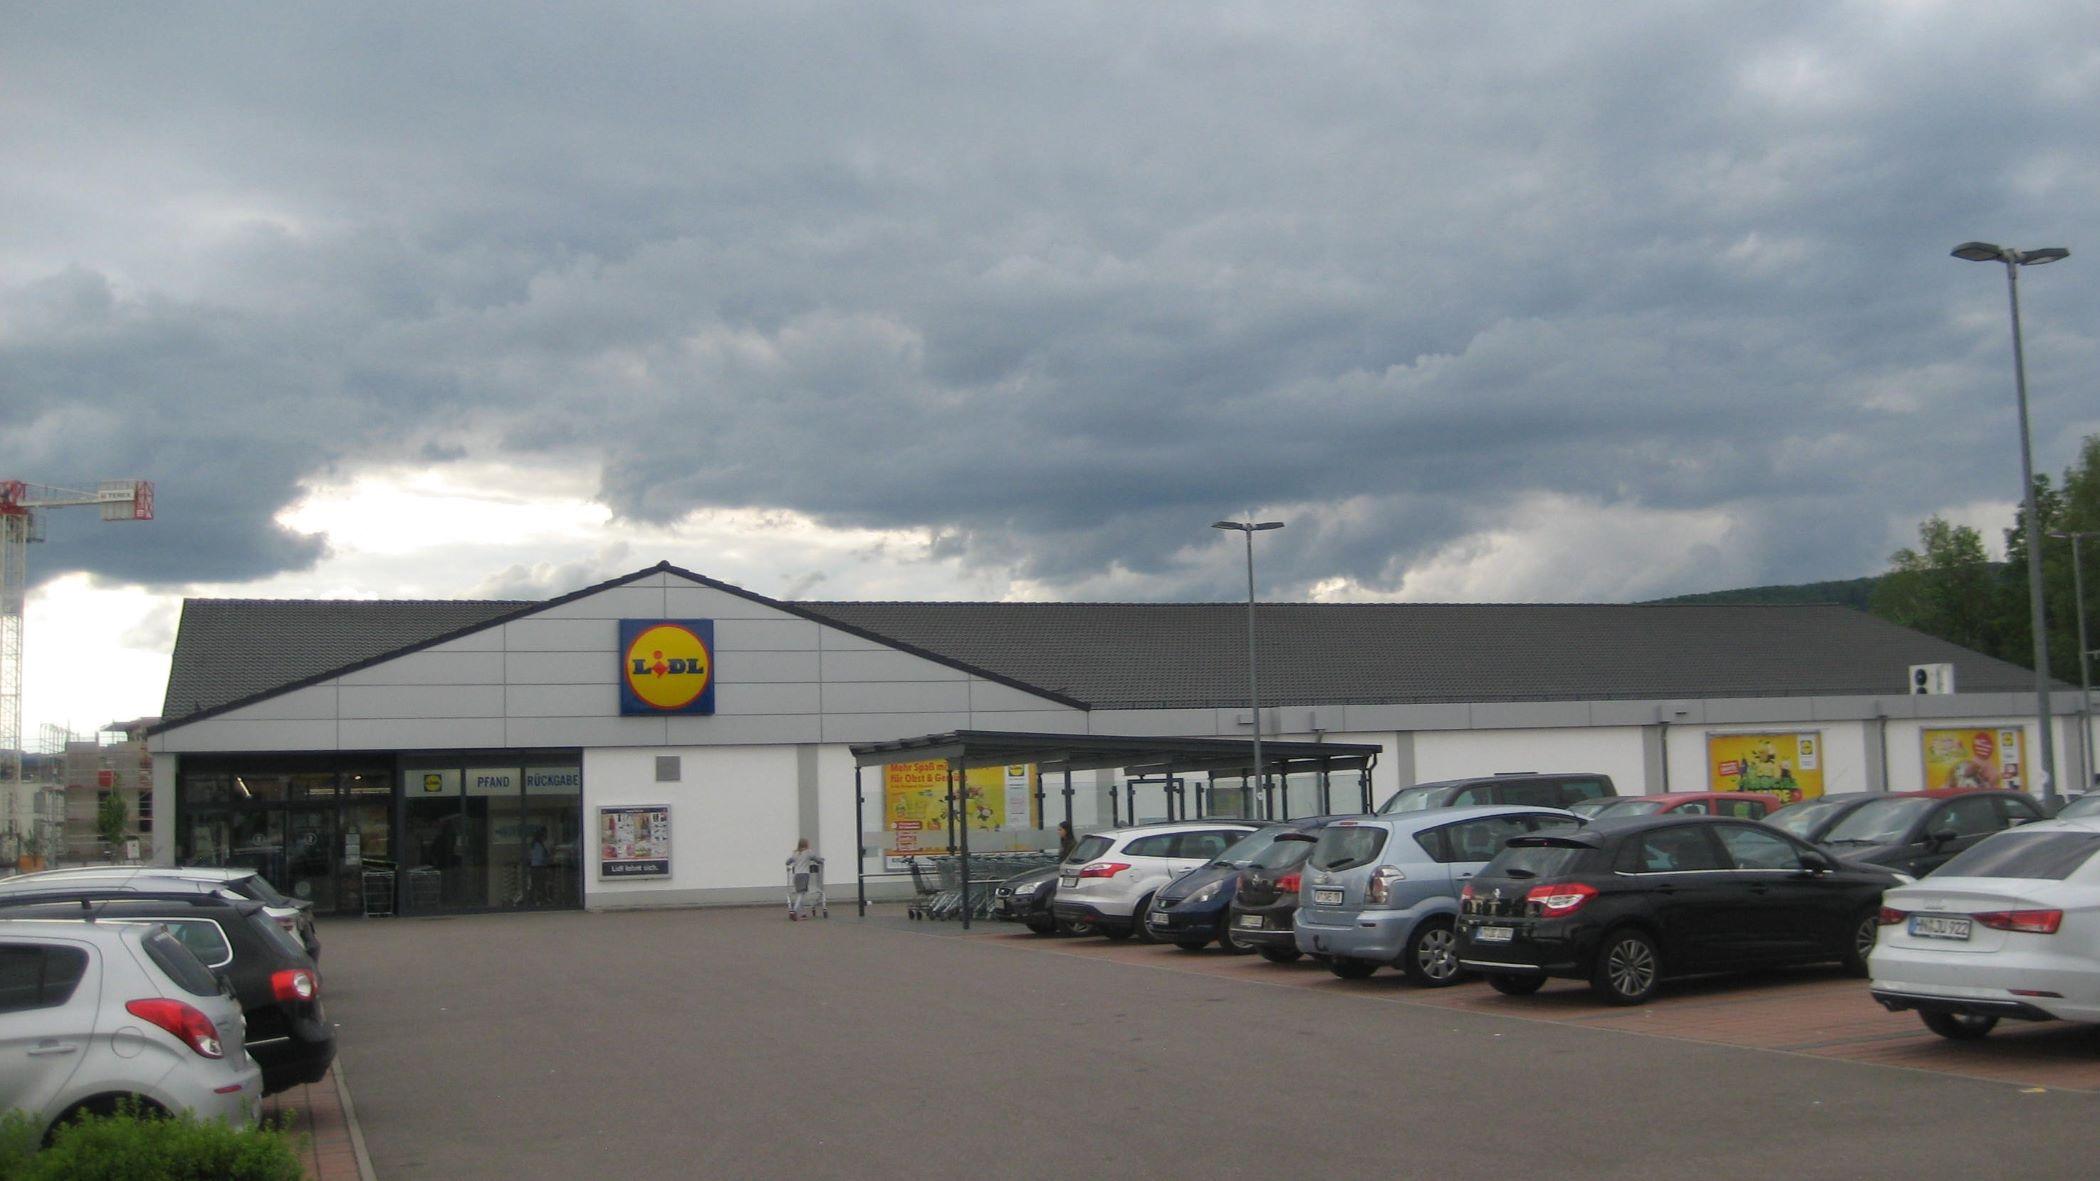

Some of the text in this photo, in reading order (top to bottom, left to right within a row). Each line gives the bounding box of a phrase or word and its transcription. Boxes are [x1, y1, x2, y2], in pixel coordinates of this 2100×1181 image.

[632, 650, 704, 678] LIDL
[477, 774, 579, 788] PFAND RÜCKGABE
[905, 773, 926, 783] Obst
[1950, 921, 1968, 935] 922
